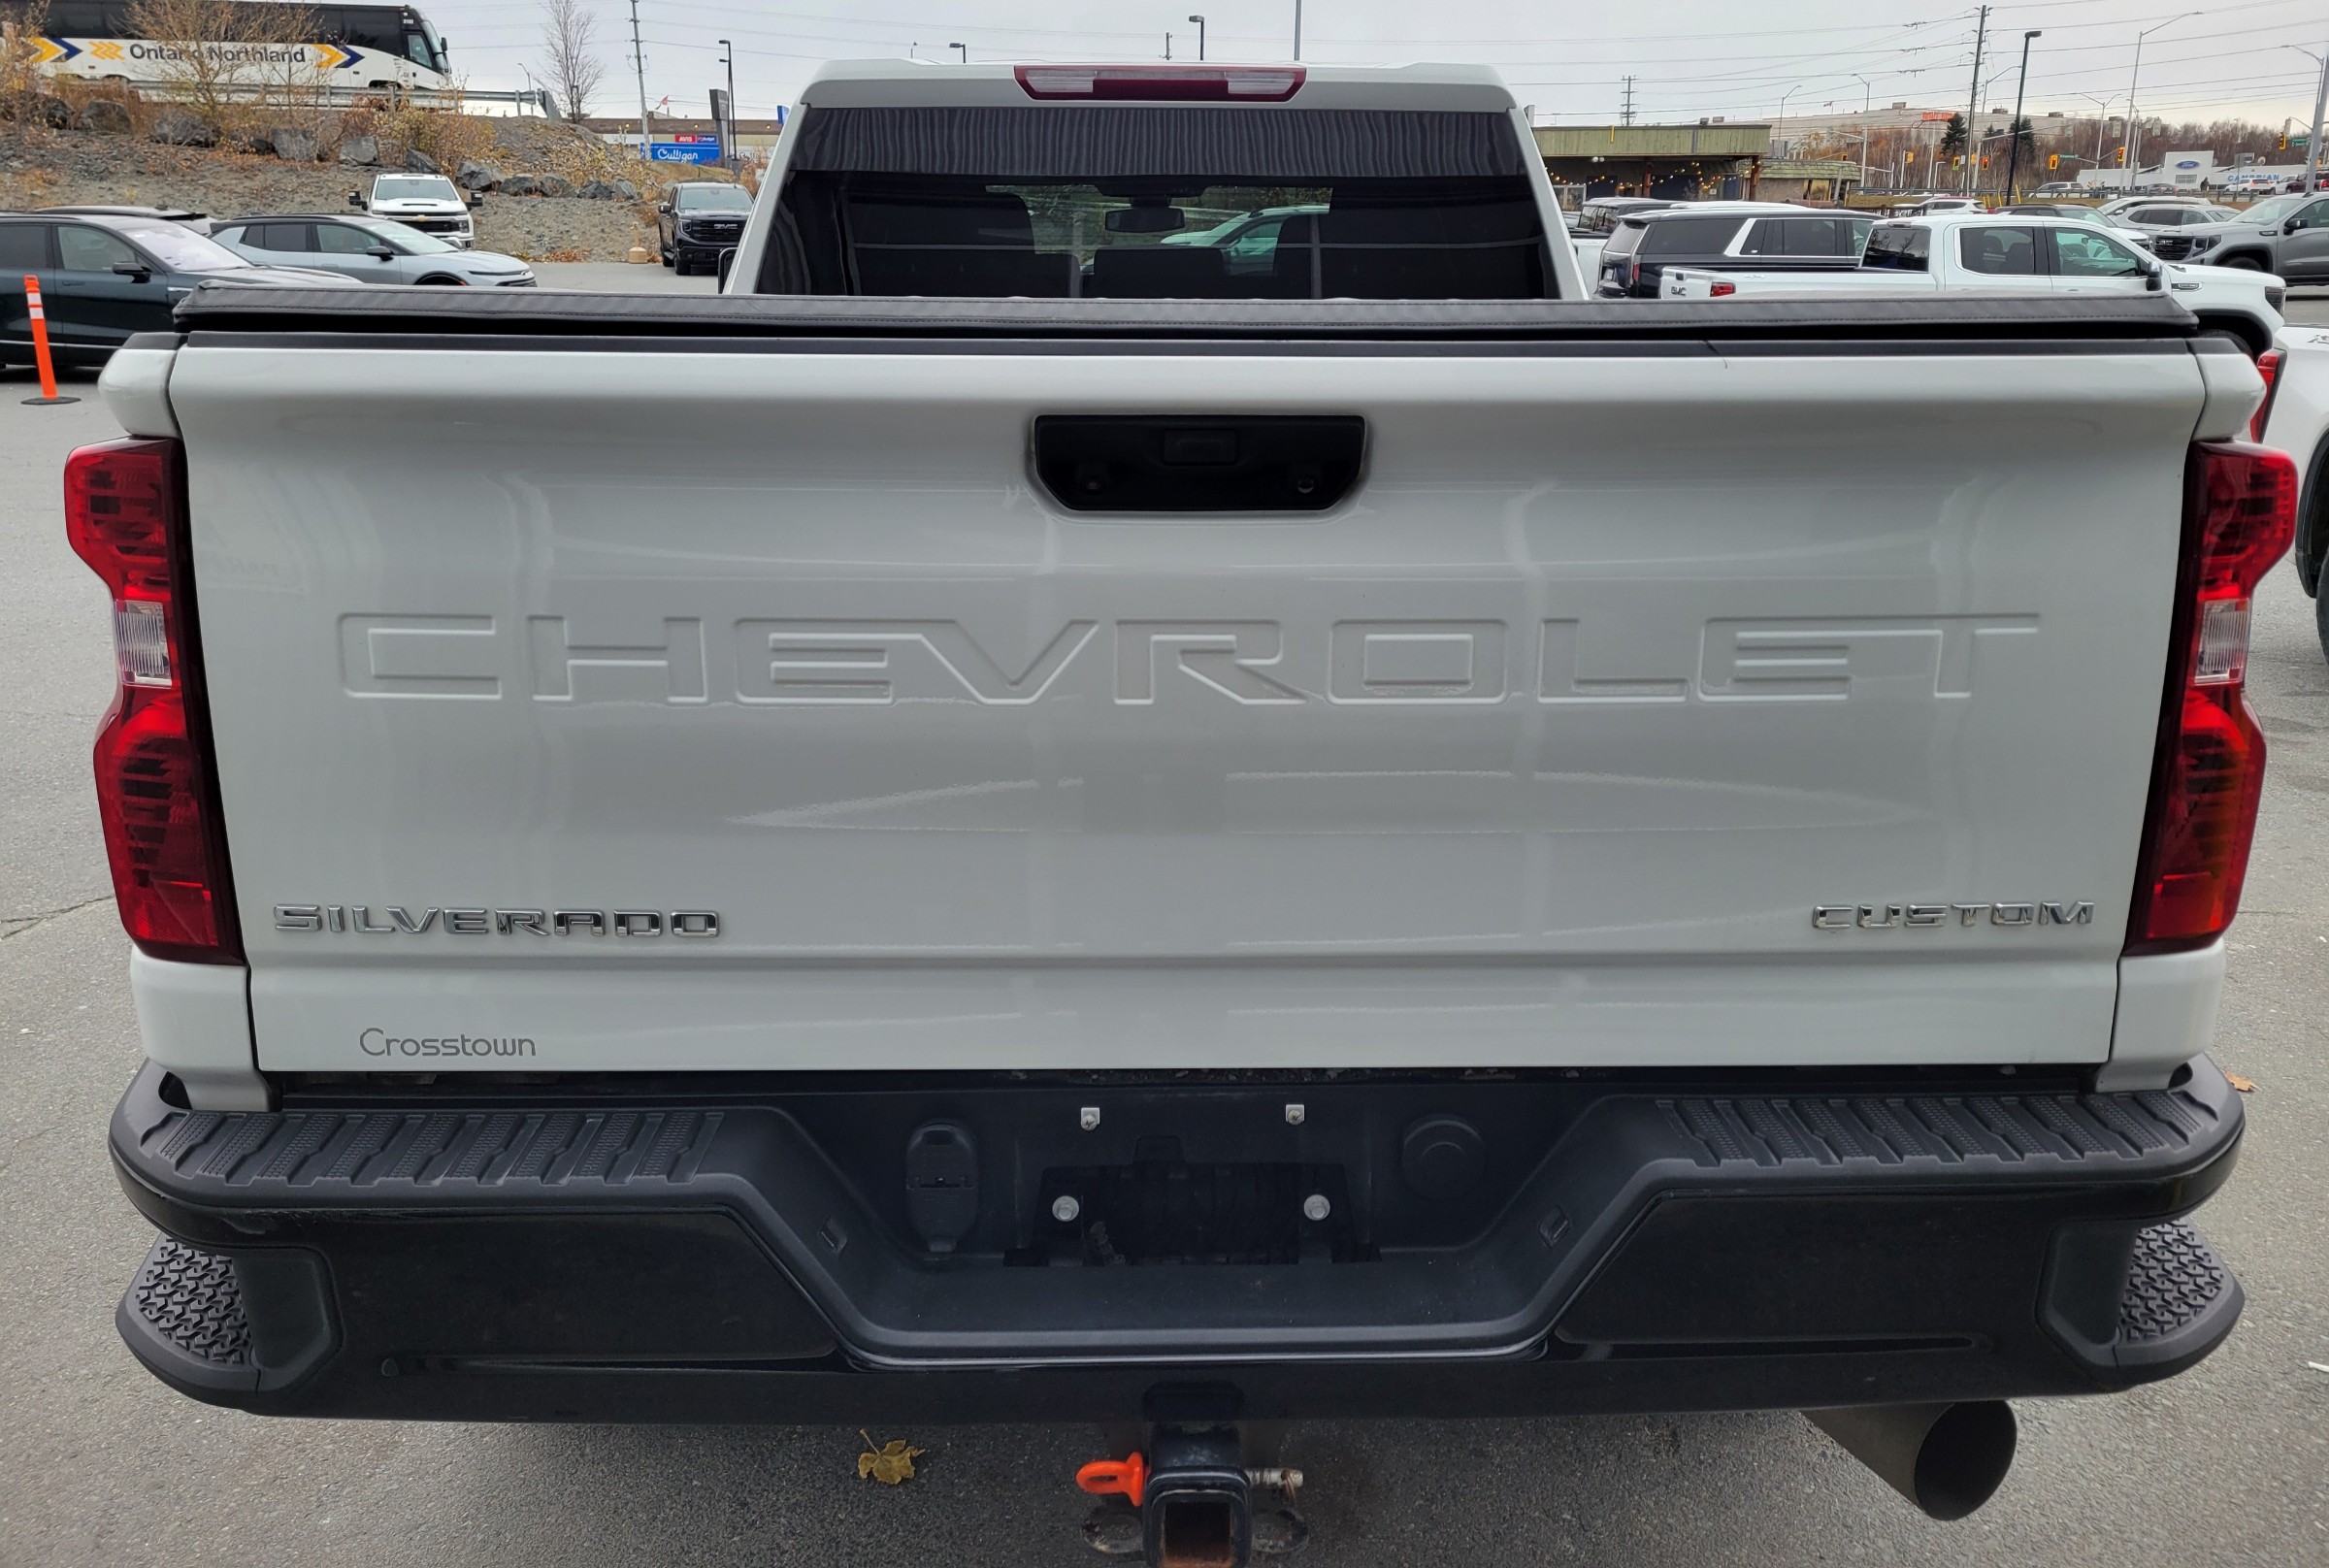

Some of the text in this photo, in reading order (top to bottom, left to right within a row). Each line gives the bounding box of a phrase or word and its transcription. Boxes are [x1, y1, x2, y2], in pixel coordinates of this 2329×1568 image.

[129, 43, 306, 62] Ontaro Northland
[657, 148, 699, 163] Culligan
[1670, 285, 1687, 296] GMC
[338, 612, 2040, 705] CHEVROLET
[274, 903, 721, 938] SILVERADO
[1813, 901, 2096, 929] CUSTOM
[359, 1028, 537, 1057] Crosstown
